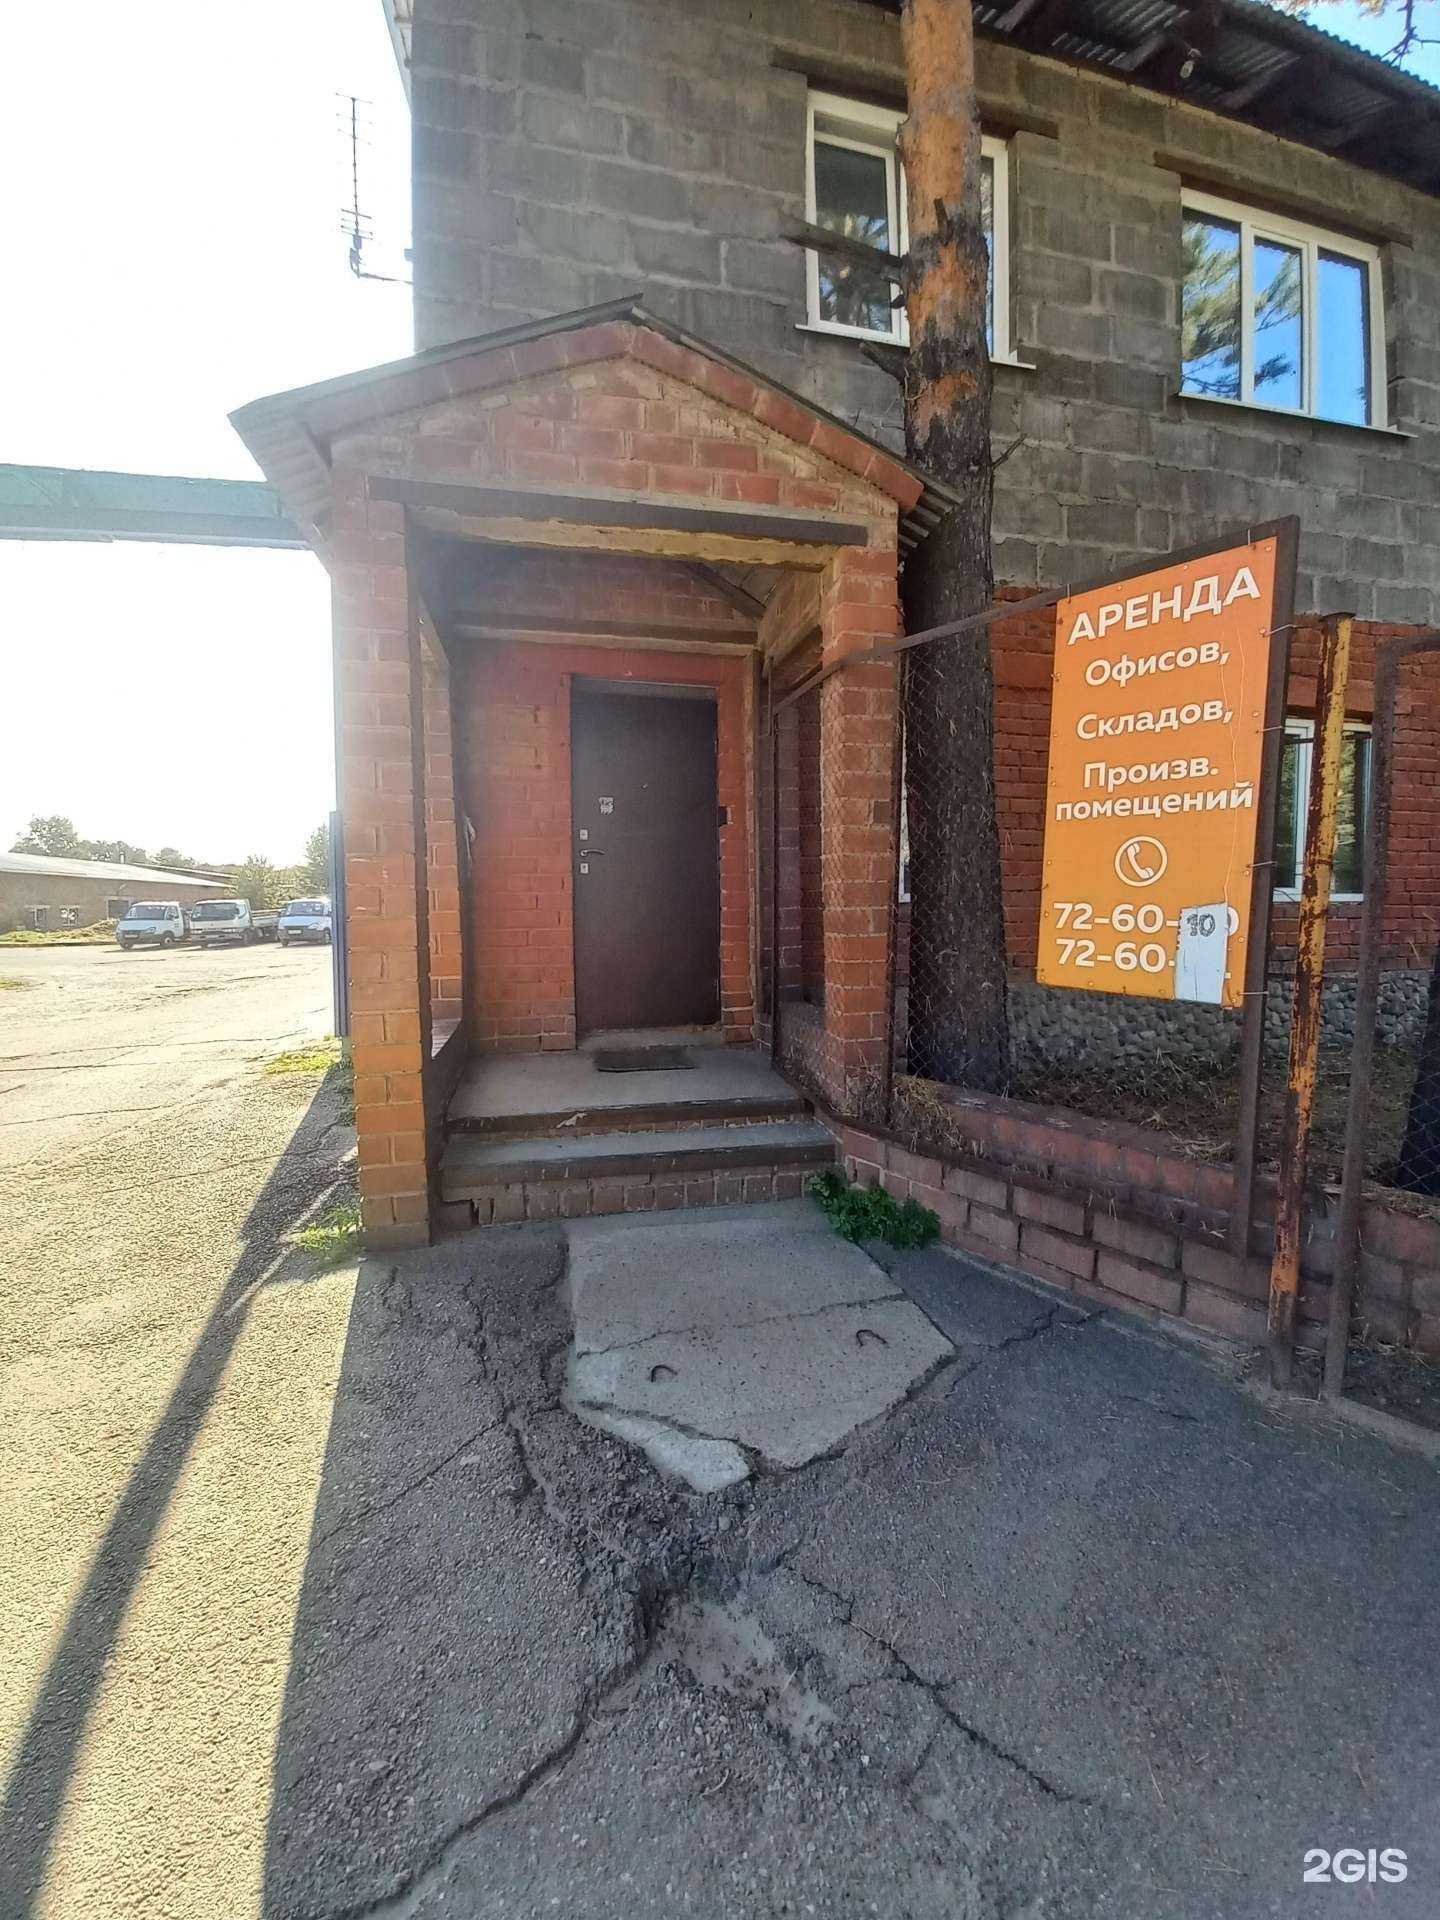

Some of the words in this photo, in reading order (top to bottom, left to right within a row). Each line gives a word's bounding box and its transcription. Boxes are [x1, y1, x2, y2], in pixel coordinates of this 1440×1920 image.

[1067, 566, 1261, 646] АРЕНДА
[1085, 641, 1229, 687] Офисов,
[1077, 700, 1233, 740] Складов,
[1083, 757, 1219, 792] Произв.
[1055, 782, 1254, 821] помещений
